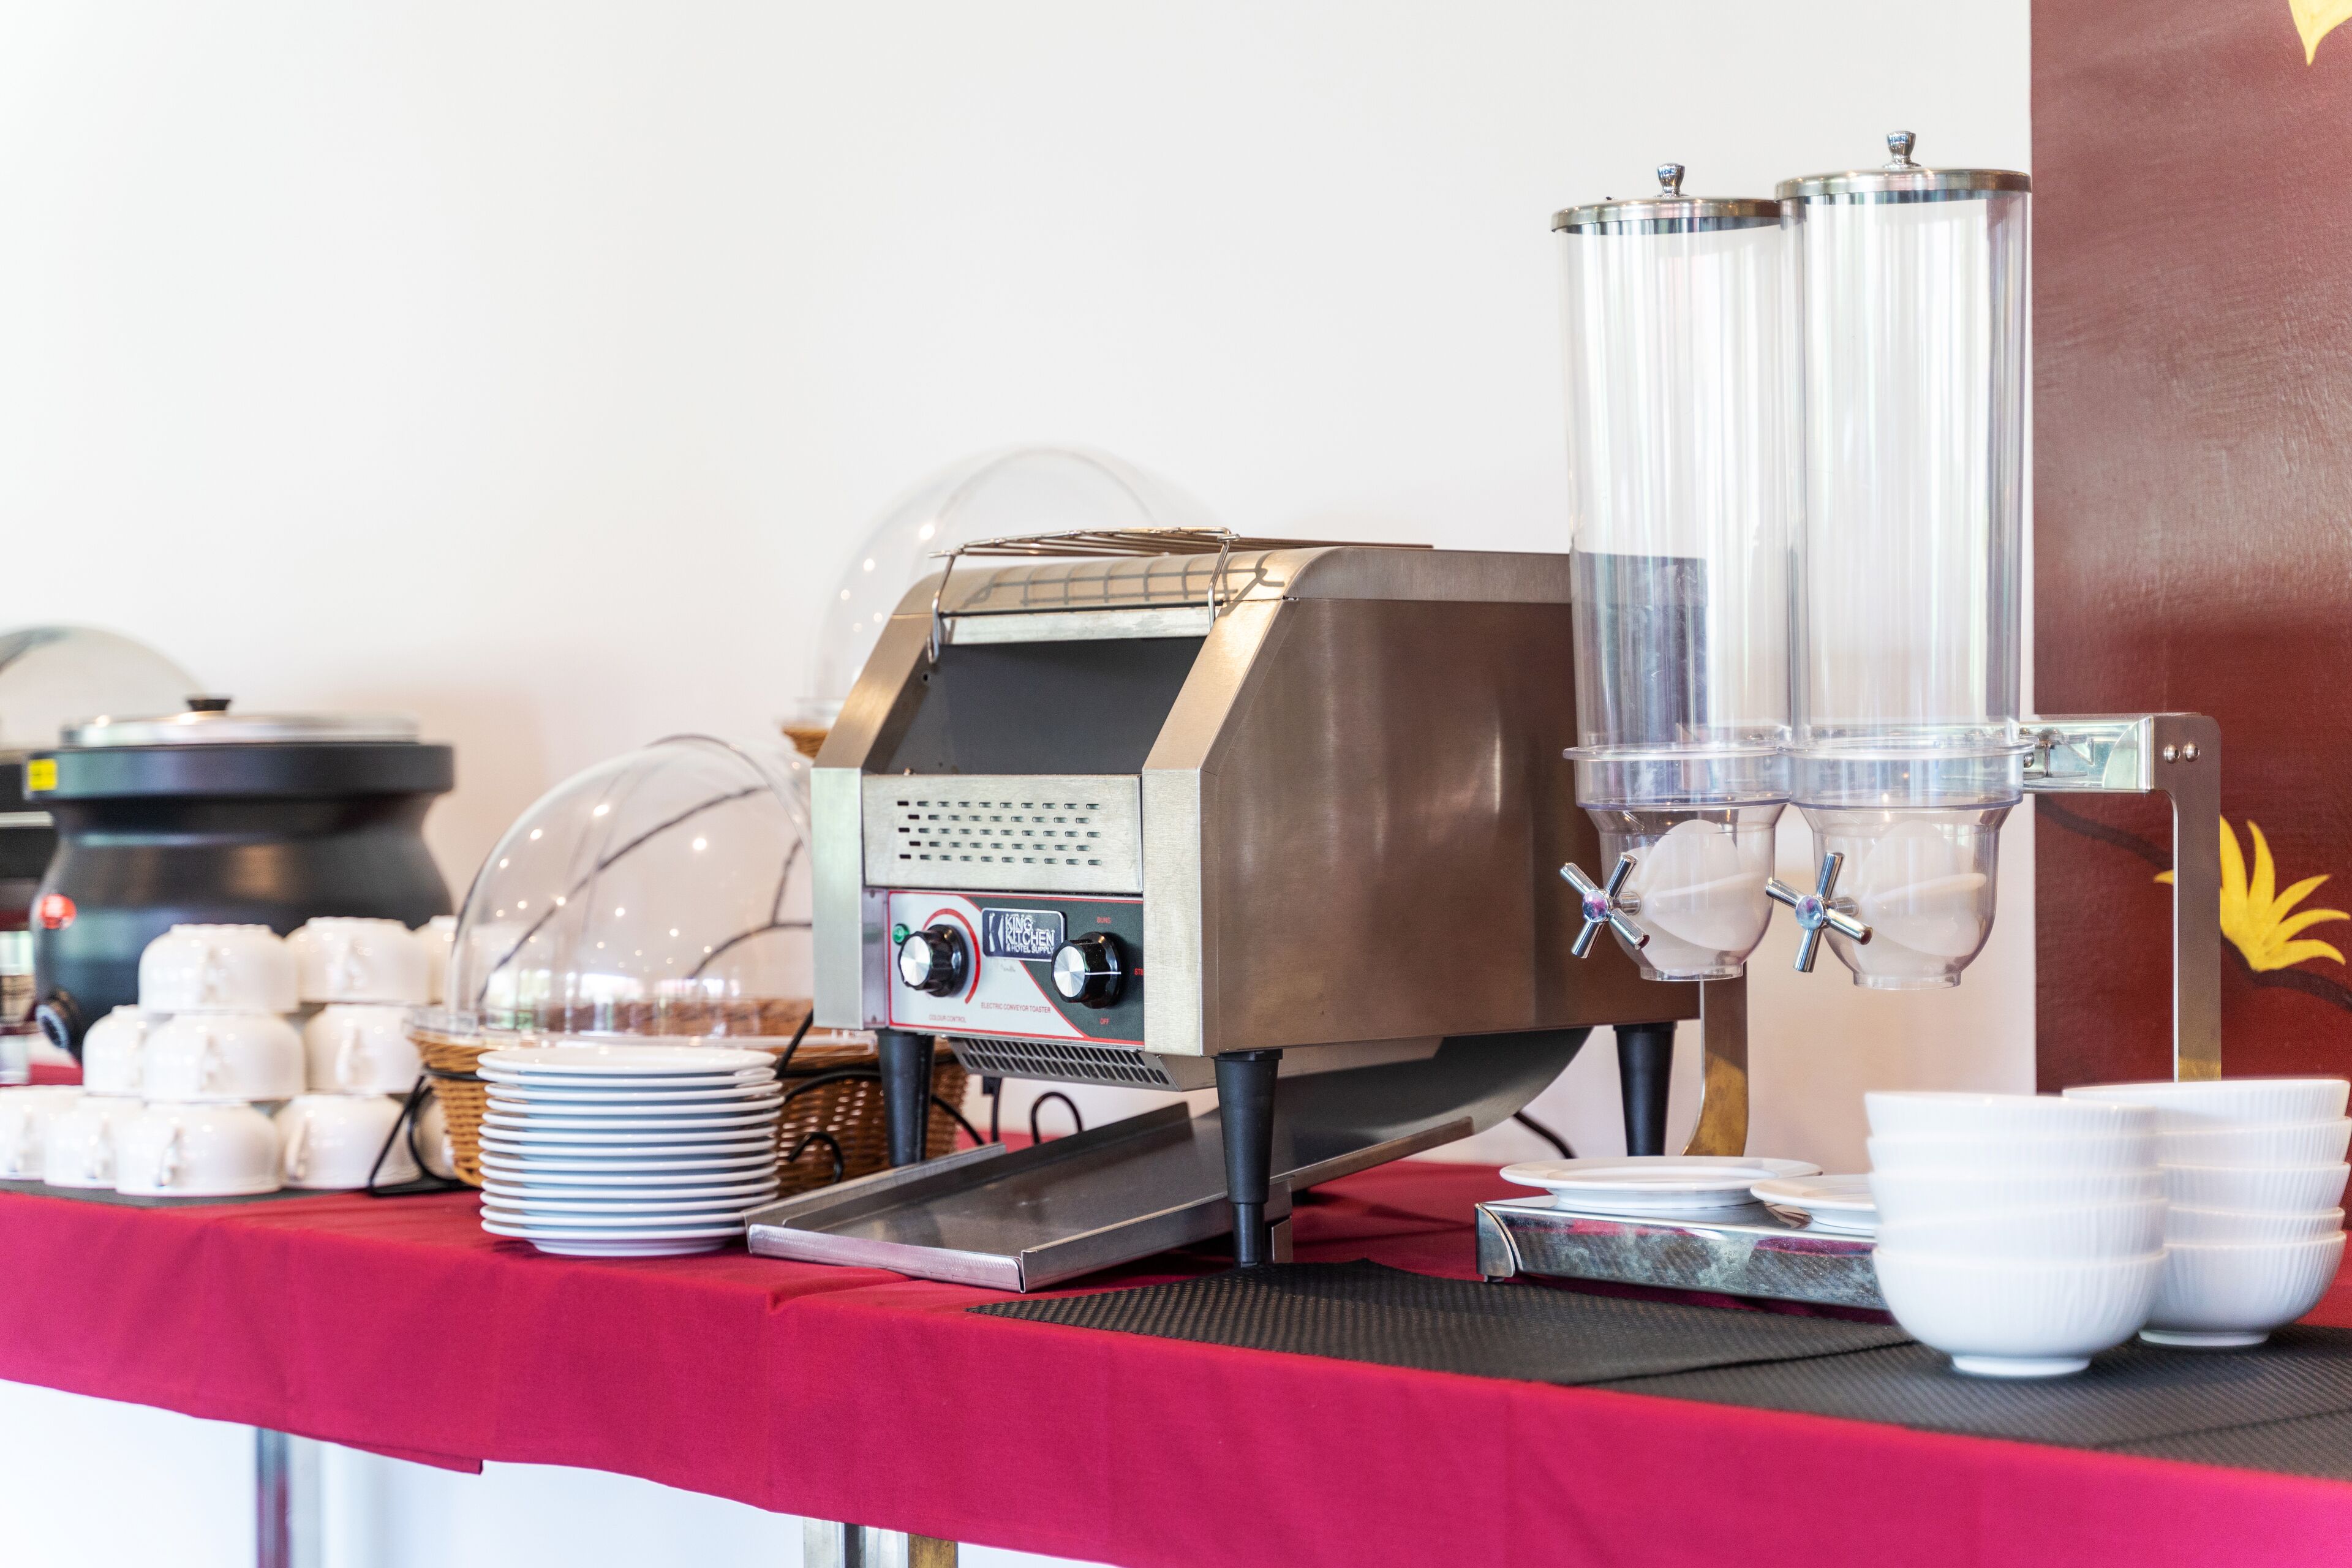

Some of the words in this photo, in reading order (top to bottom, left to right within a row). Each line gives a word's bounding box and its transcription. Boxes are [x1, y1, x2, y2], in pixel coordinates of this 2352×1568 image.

[1005, 913, 1033, 932] KING
[1005, 929, 1055, 946] KITCHEN
[1011, 944, 1030, 953] HOTEL
[1031, 945, 1055, 954] SUPPLY
[981, 1001, 1003, 1010] ELECTRIC
[1004, 1003, 1029, 1012] CONVEYOR
[1030, 1005, 1051, 1014] TOASTER
